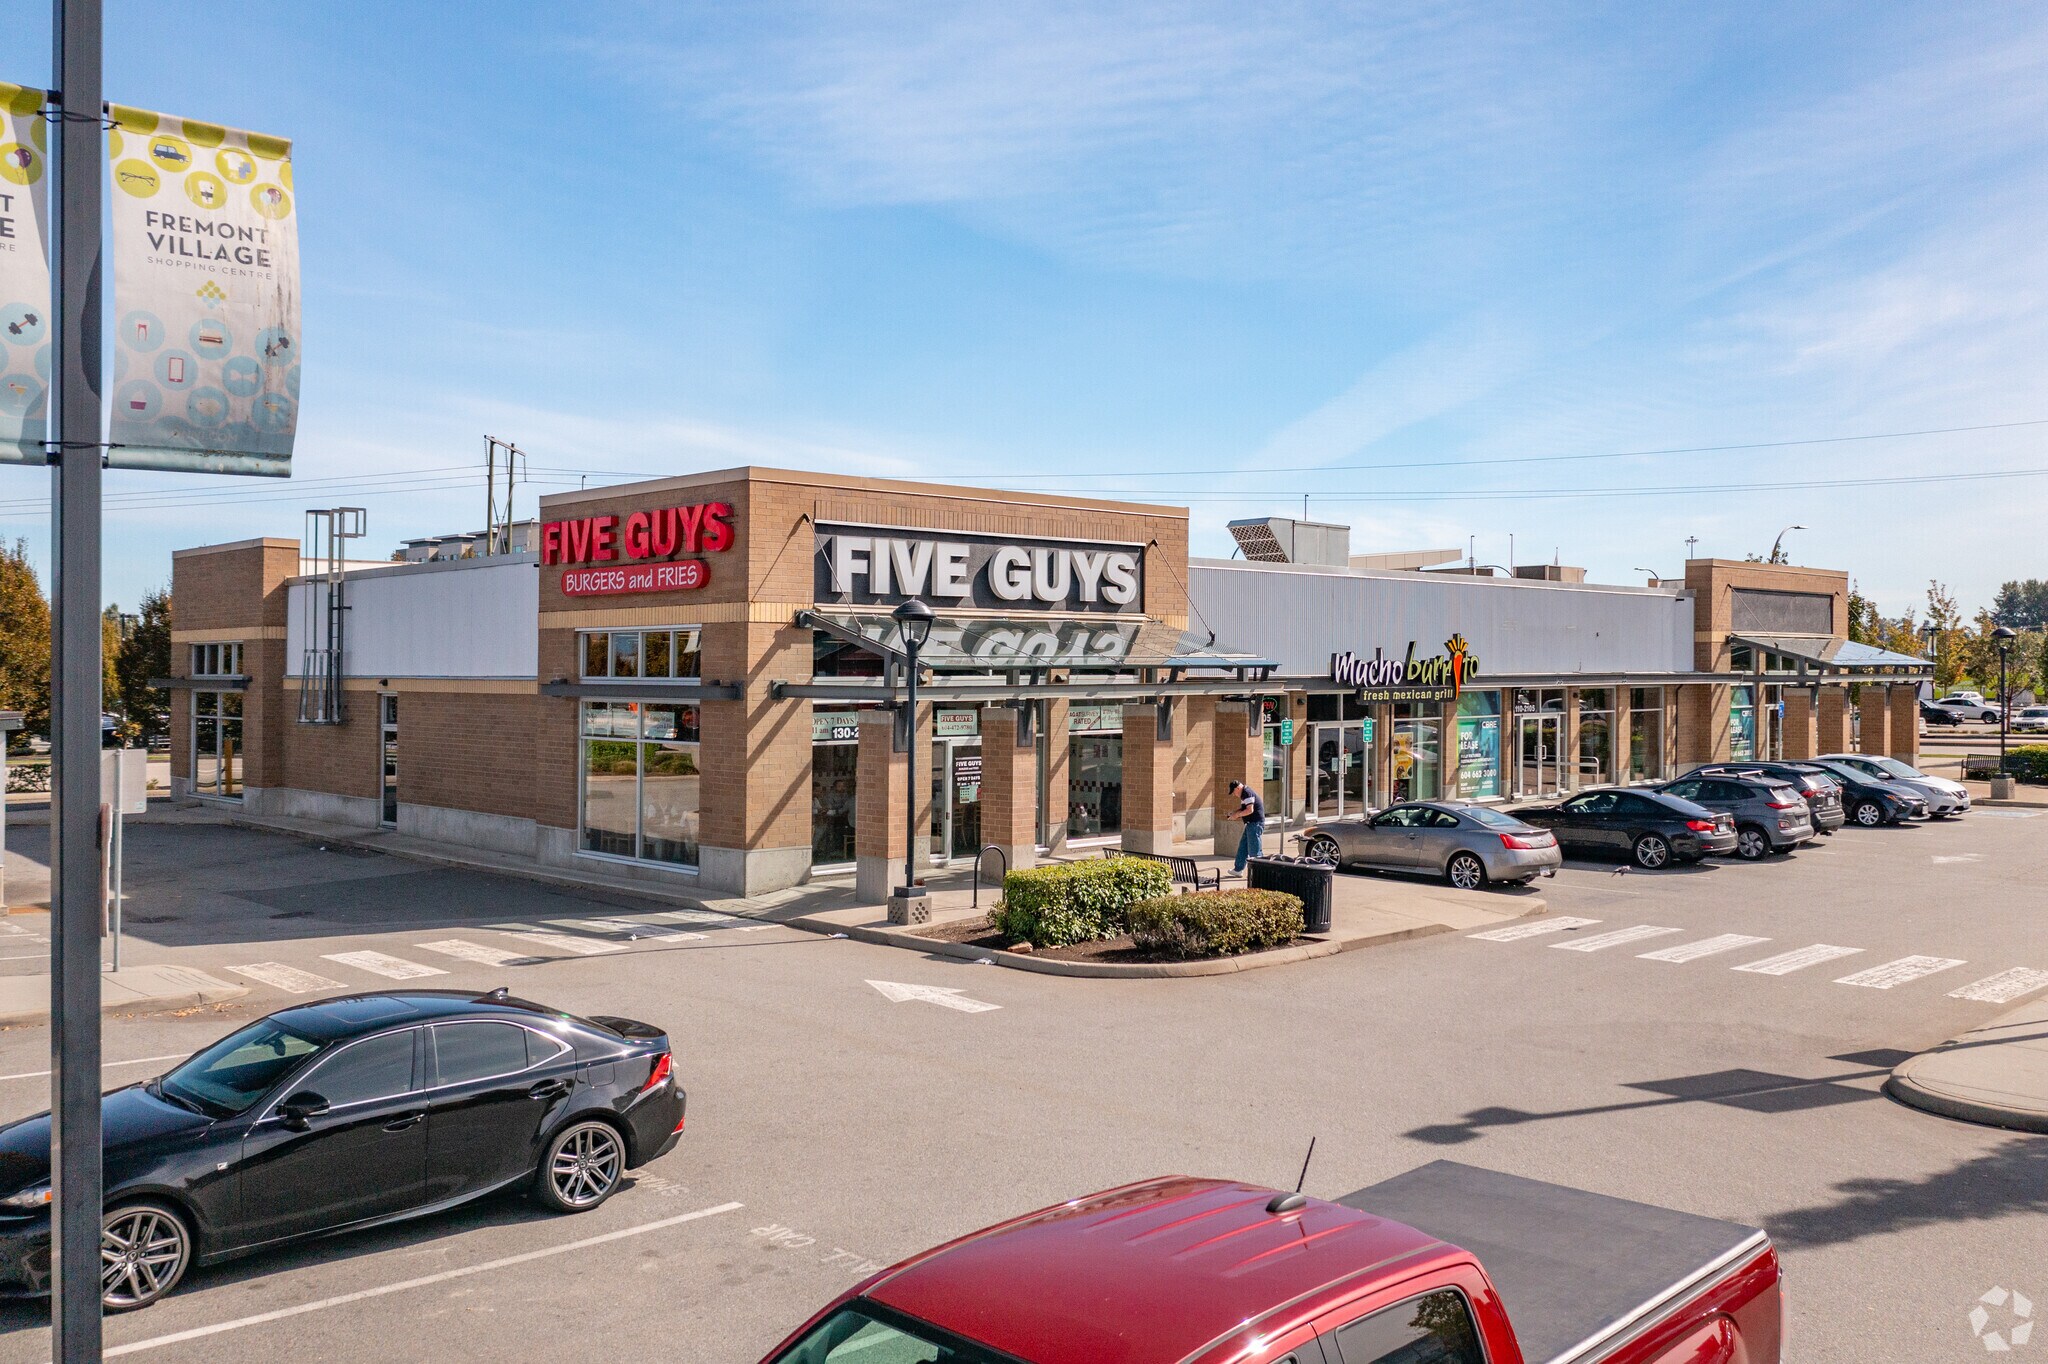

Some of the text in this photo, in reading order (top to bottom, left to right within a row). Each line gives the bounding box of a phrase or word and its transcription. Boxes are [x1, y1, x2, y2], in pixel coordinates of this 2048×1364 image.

[146, 210, 269, 244] FREMONT
[147, 231, 271, 268] VILLAGE
[148, 256, 272, 280] SHOPPING CENTRE
[542, 502, 735, 565] FIVE GUYS
[566, 565, 698, 592] BURGERS and FRIES
[831, 535, 1137, 605] FIVE GUYS
[1331, 646, 1404, 688] Macho
[1363, 688, 1454, 701] fresh mexican grill
[1264, 701, 1275, 710] PEN
[830, 717, 835, 725] 7
[836, 717, 855, 725] DAYS
[1460, 731, 1474, 741] FOR
[1460, 741, 1479, 750] LEASE
[955, 760, 968, 768] FIVE
[1460, 771, 1471, 779] 604
